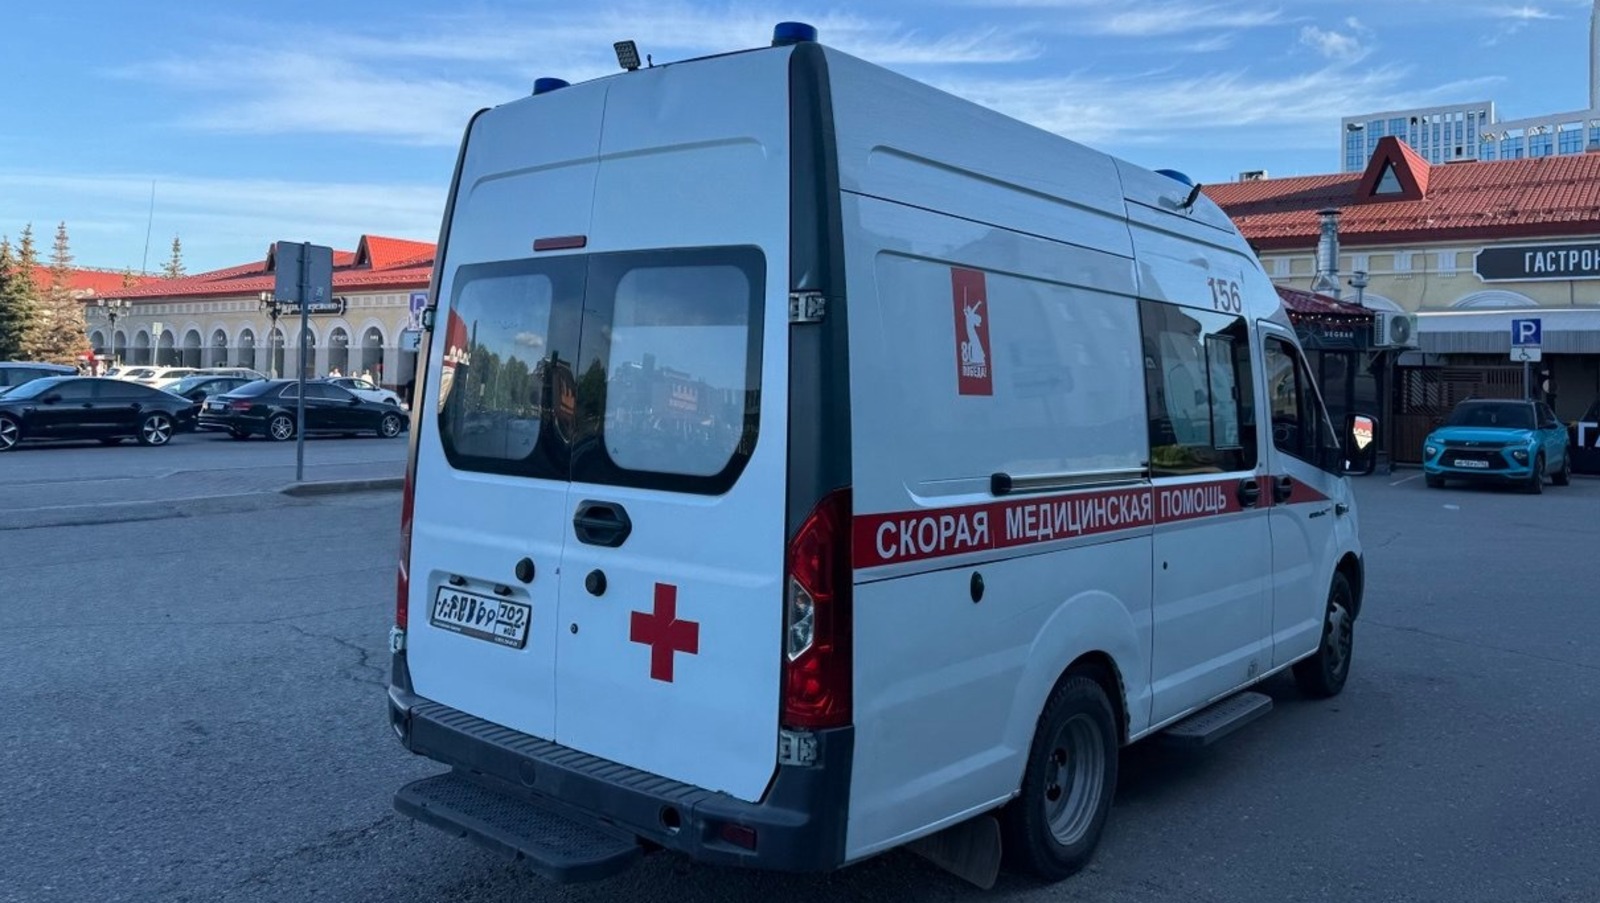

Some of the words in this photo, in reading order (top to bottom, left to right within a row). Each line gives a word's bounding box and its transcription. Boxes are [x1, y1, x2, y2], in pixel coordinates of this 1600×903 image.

[1207, 276, 1242, 314] 156
[1519, 321, 1536, 343] P
[1578, 421, 1600, 447] Г
[876, 511, 989, 559] СКОРАЯ
[1005, 493, 1151, 541] МЕДИЦИНСКАЯ
[1161, 485, 1227, 518] ПОМОЩЬ
